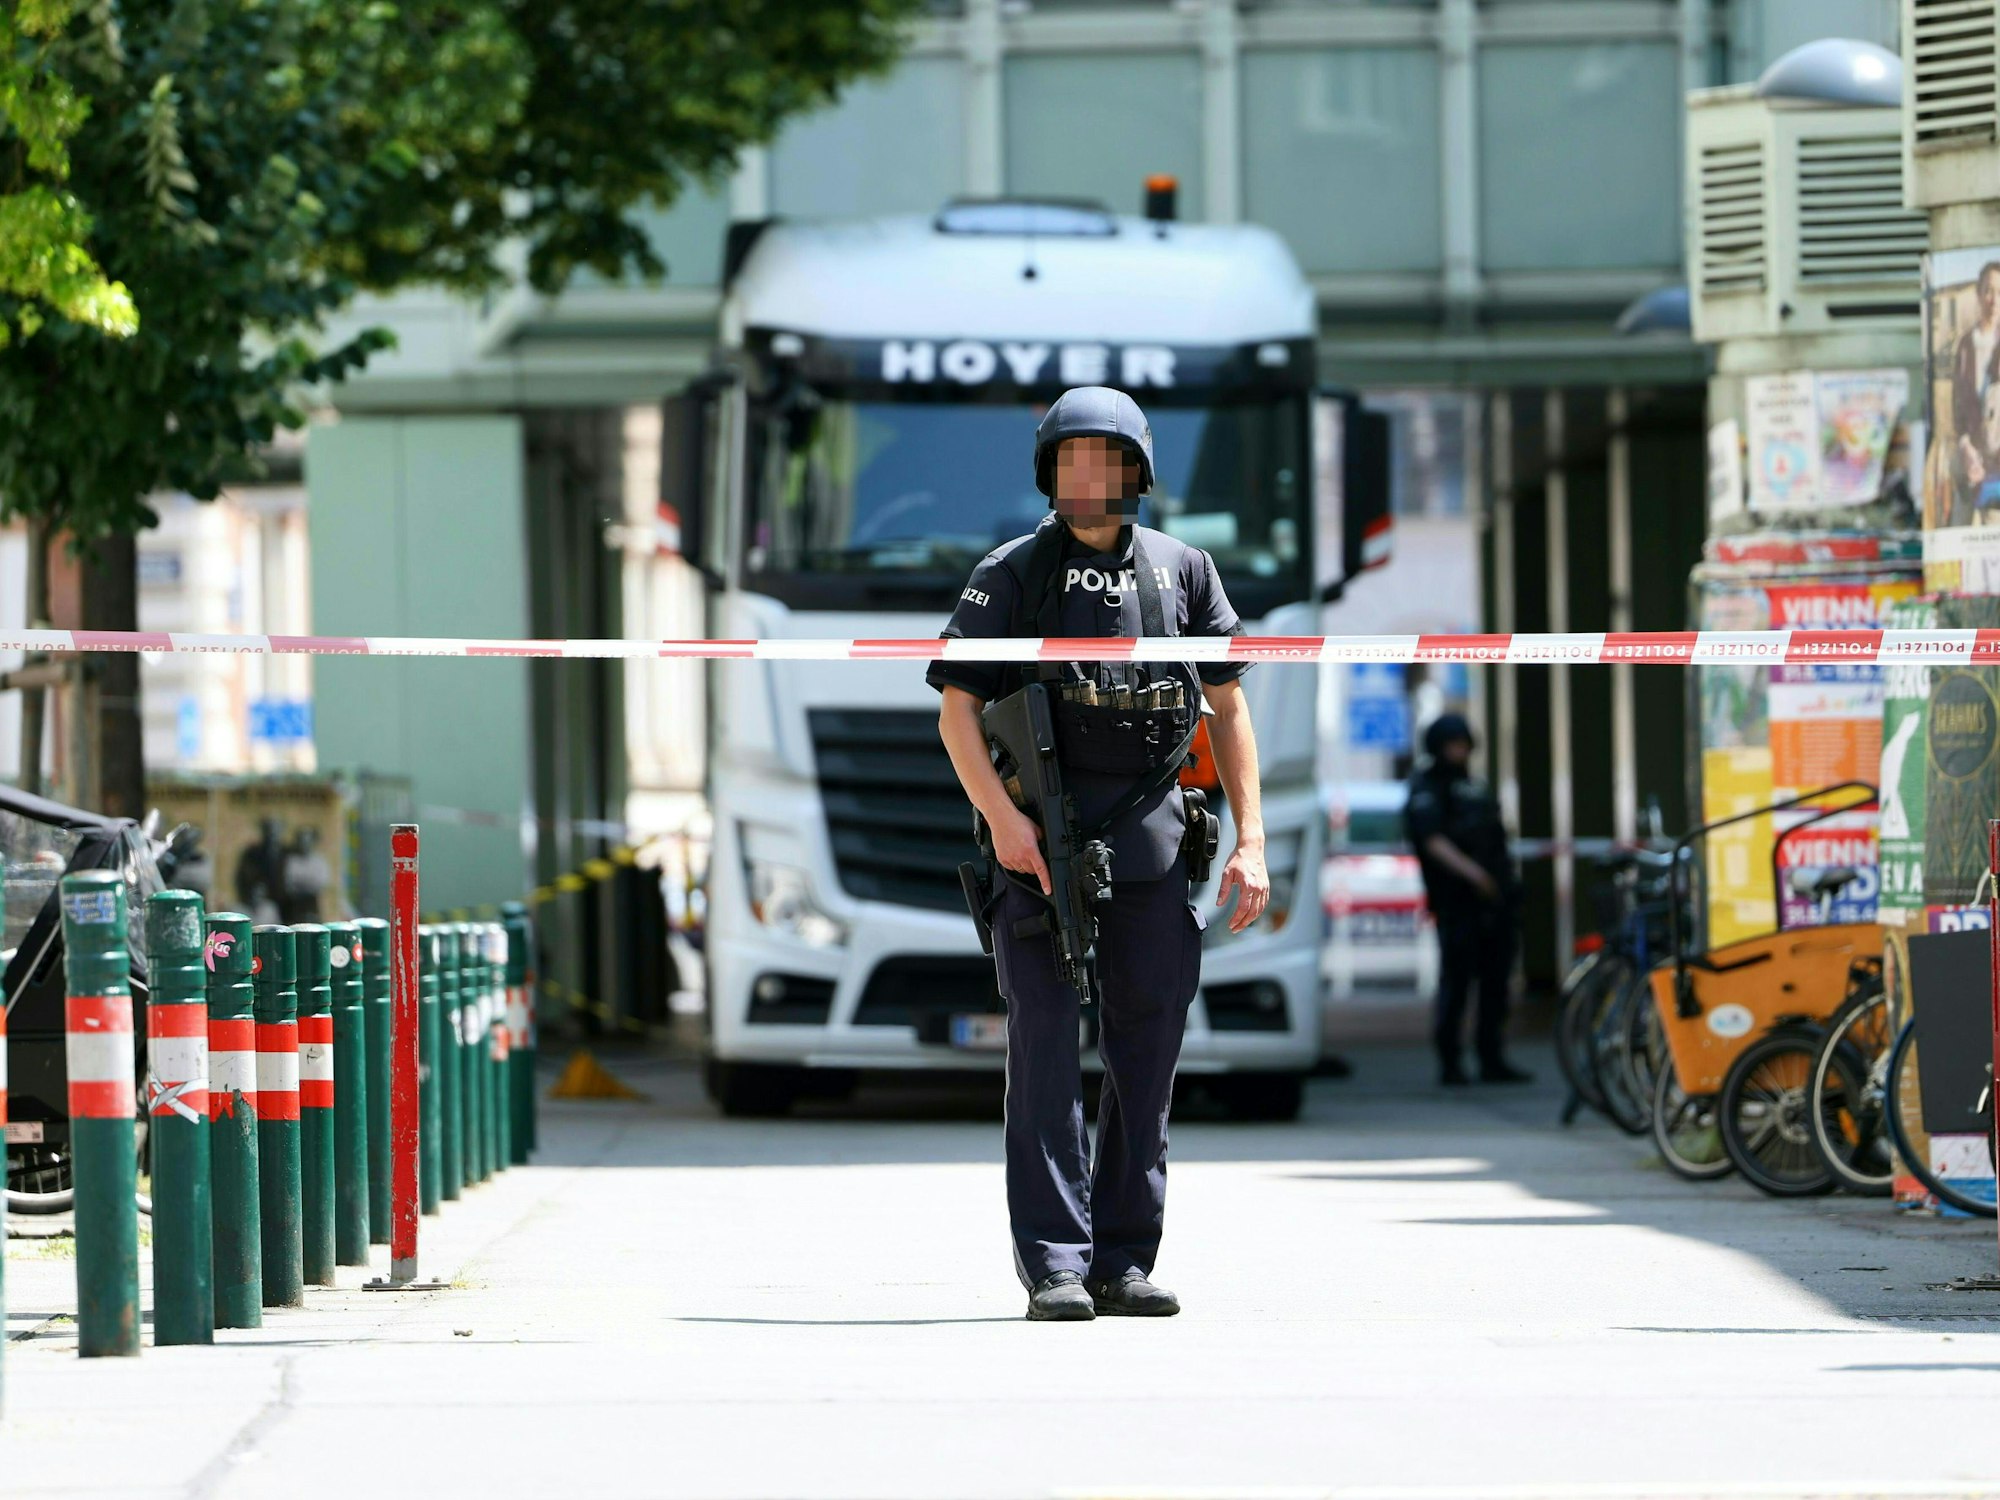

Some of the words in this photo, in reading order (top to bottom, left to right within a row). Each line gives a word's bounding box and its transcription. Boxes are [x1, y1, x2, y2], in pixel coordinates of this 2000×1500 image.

[881, 341, 1177, 388] HOYER
[1431, 647, 1500, 659] POLIZEI
[1524, 646, 1593, 658] POLIZEI
[1617, 645, 1687, 657] POLIZEI
[1711, 643, 1779, 655] POLIZEI
[1804, 642, 1873, 655] POLIZEI
[1897, 642, 1965, 653] POLIZEI
